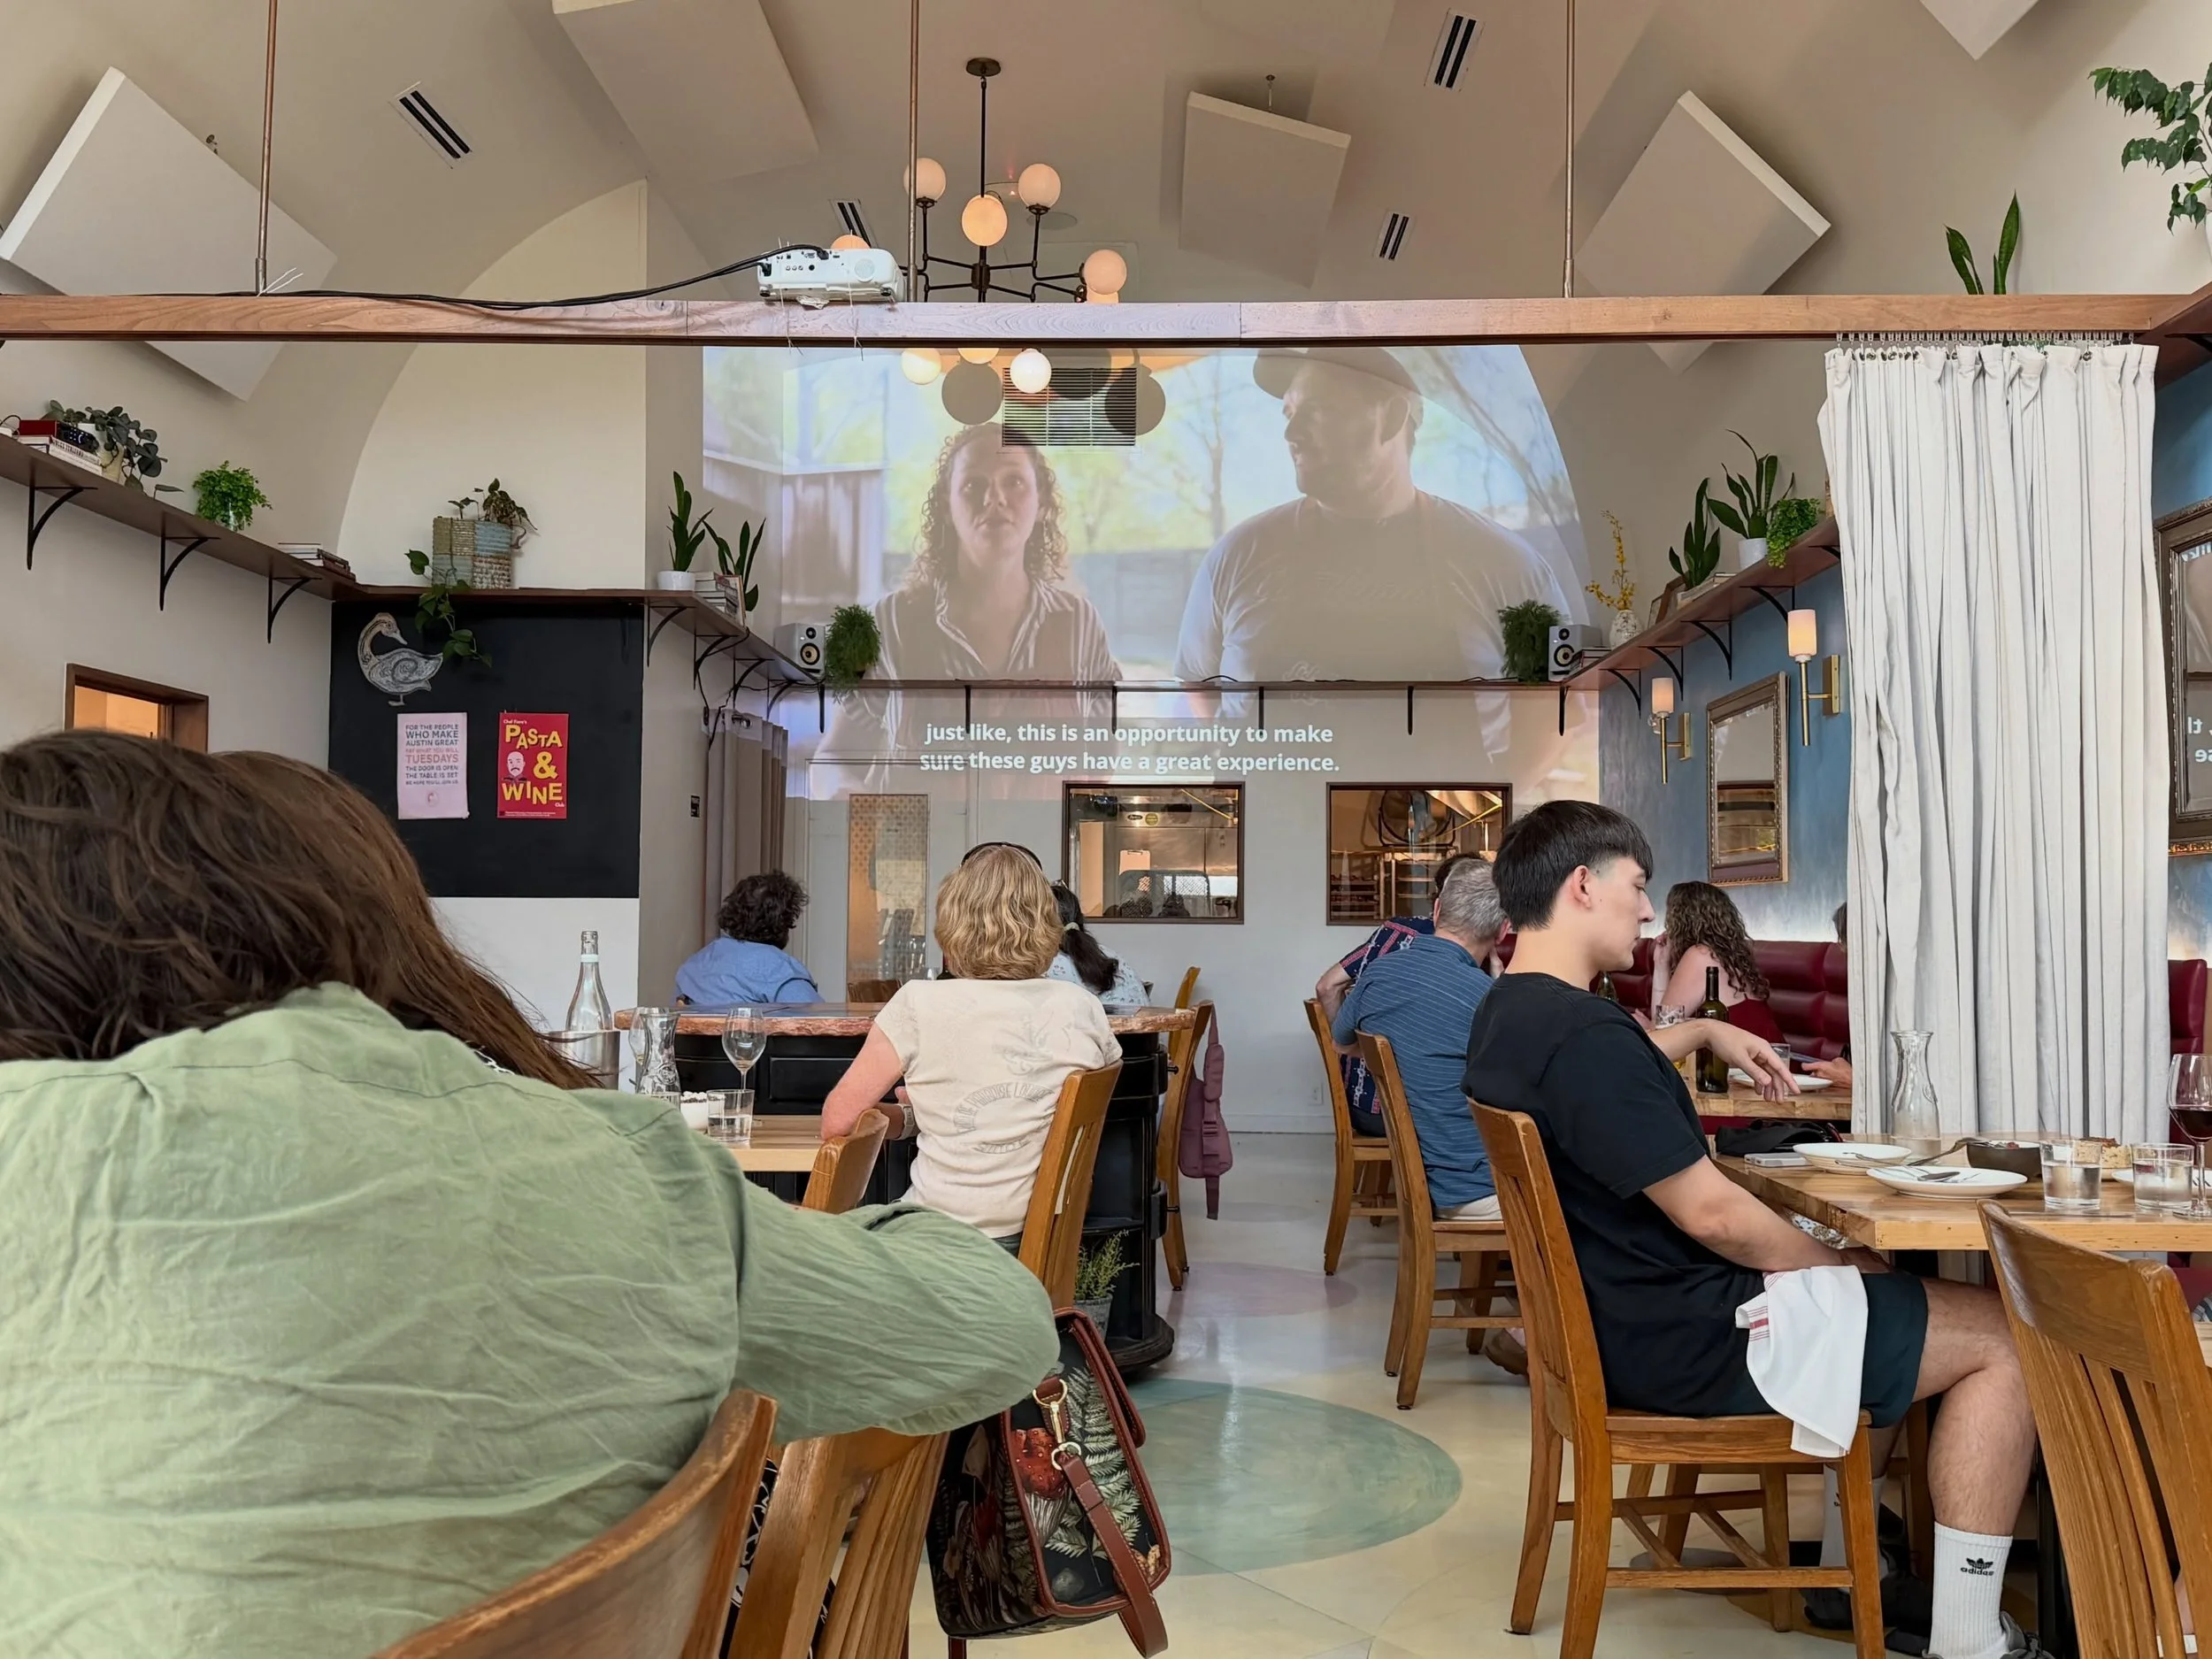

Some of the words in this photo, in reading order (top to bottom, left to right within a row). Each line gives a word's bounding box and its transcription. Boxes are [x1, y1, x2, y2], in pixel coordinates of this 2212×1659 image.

[432, 730, 458, 739] MAKE
[505, 724, 563, 749] PASTA
[925, 723, 964, 745] just
[970, 723, 1011, 744] like,
[1018, 724, 1056, 741] this
[1062, 724, 1078, 741] is
[1083, 727, 1109, 741] an
[1115, 724, 1240, 747] opportunity
[1245, 726, 1268, 742] to
[1274, 724, 1333, 742] make
[405, 754, 458, 764] TUESDAYS
[533, 751, 558, 779] &
[920, 754, 964, 771] sure
[969, 751, 1025, 770] these
[1030, 754, 1078, 774] guys
[1083, 752, 1133, 770] have
[1138, 756, 1150, 770] a
[1155, 754, 1211, 774] great
[1217, 753, 1340, 775] experience.
[502, 780, 563, 805] WINE
[1960, 1567, 1995, 1577] adidas
